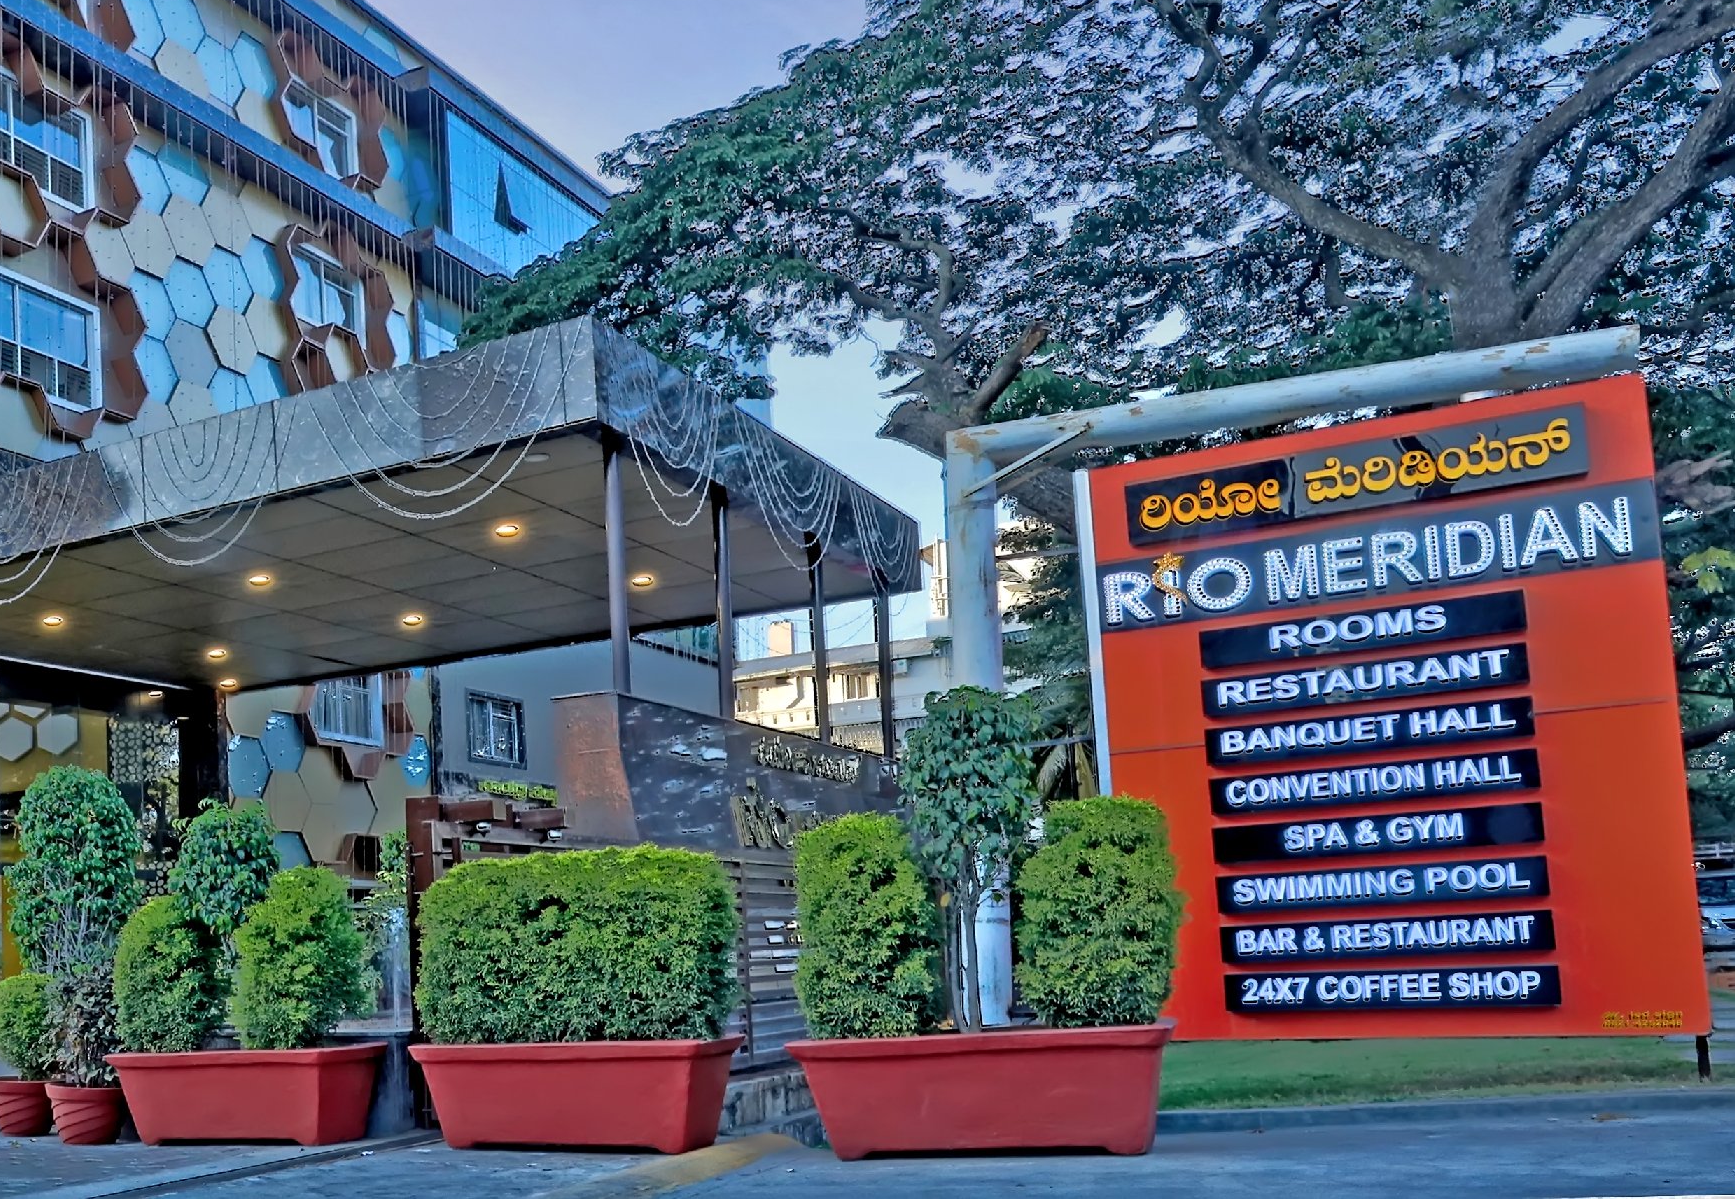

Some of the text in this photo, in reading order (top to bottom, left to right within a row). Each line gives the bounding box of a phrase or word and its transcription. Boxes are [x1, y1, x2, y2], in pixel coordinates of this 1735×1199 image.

[1140, 418, 1571, 531] ರಿಯೋ ಮೆರಿಡಿಯನ್
[1103, 496, 1633, 626] RIO MERIDIAN
[1268, 605, 1447, 652] ROOMS
[1217, 649, 1509, 707] RESTAURANT
[1221, 704, 1516, 755] BANQUET HALL
[1225, 755, 1522, 806] CONVENTION HALL
[1284, 812, 1464, 851] SPA & GYM
[1233, 862, 1531, 905] SWIMMING POOL
[1236, 915, 1535, 955] BAR & RESTAURANT
[1241, 970, 1541, 1005] 24X7 COFFEE SHOP
